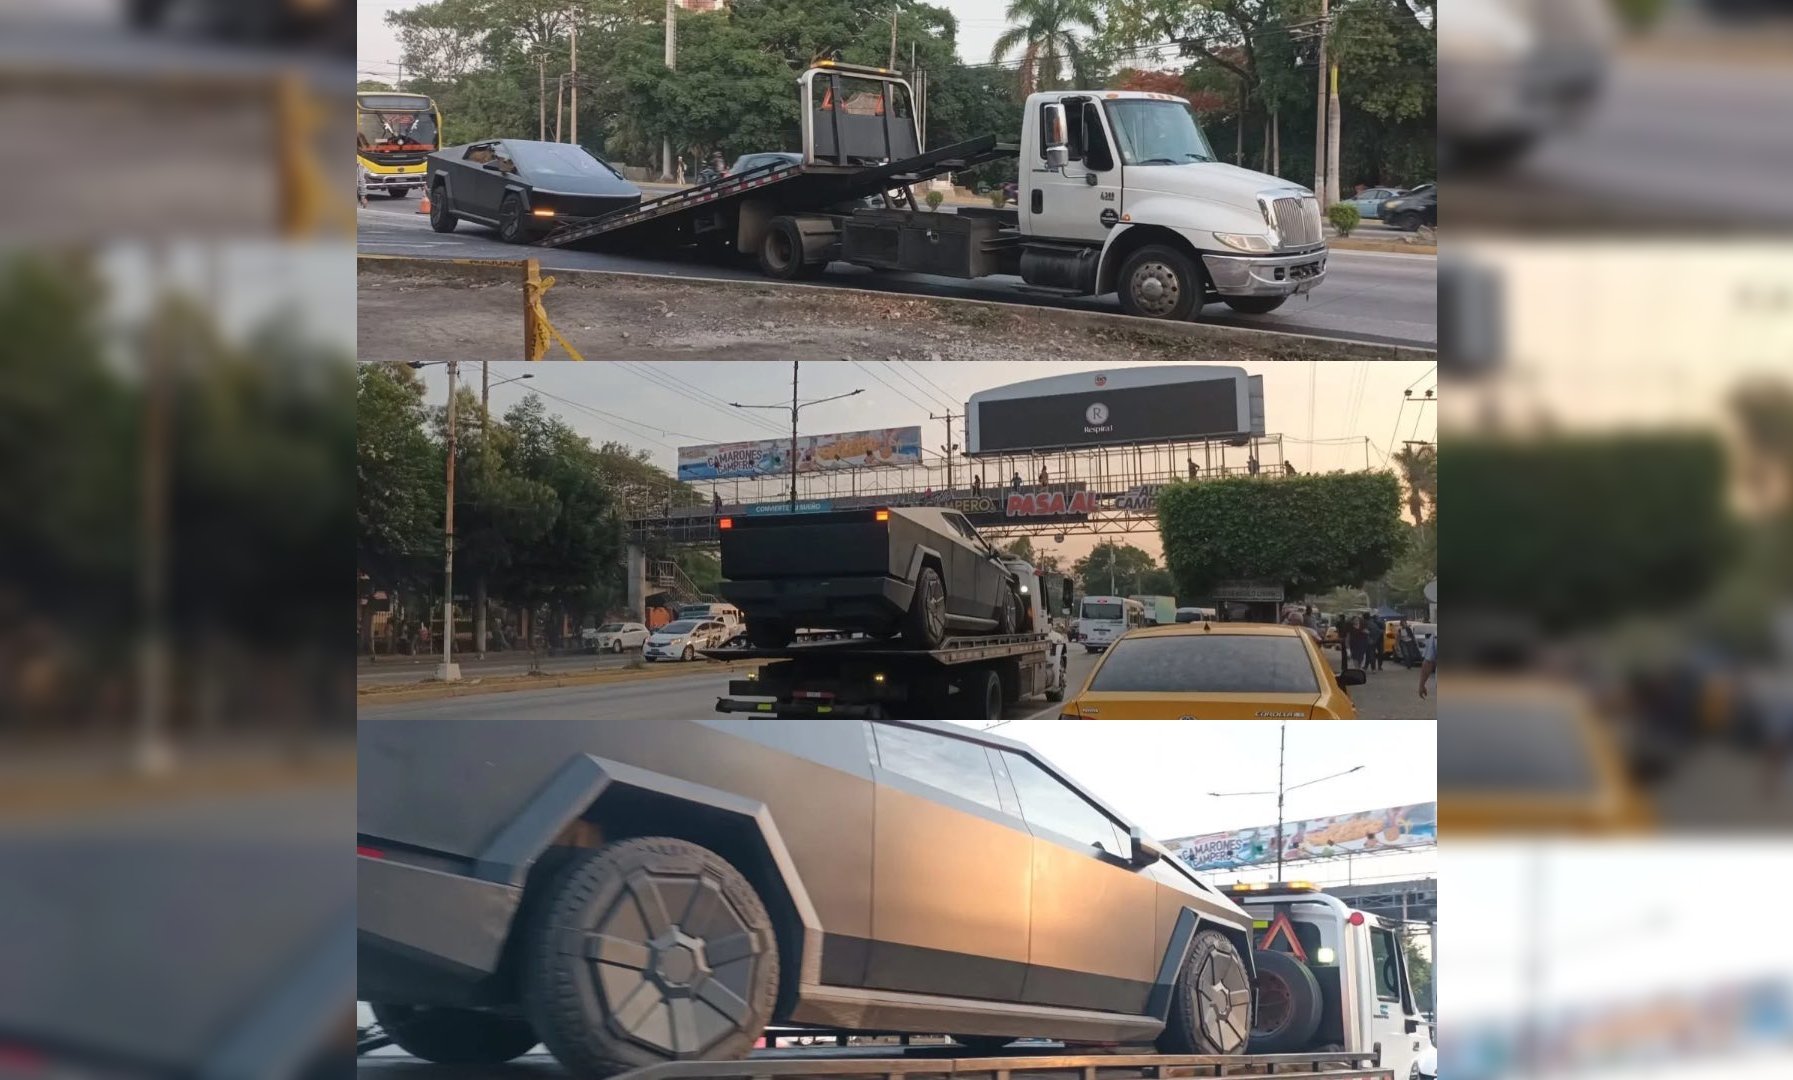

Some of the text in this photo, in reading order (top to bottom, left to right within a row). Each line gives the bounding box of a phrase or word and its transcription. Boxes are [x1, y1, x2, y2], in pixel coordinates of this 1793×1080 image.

[1093, 407, 1102, 420] R
[707, 449, 763, 467] CAMARONES
[755, 504, 790, 513] CONVIERTE
[1006, 490, 1098, 517] PASA AL
[1182, 840, 1242, 860] CAMARONES
